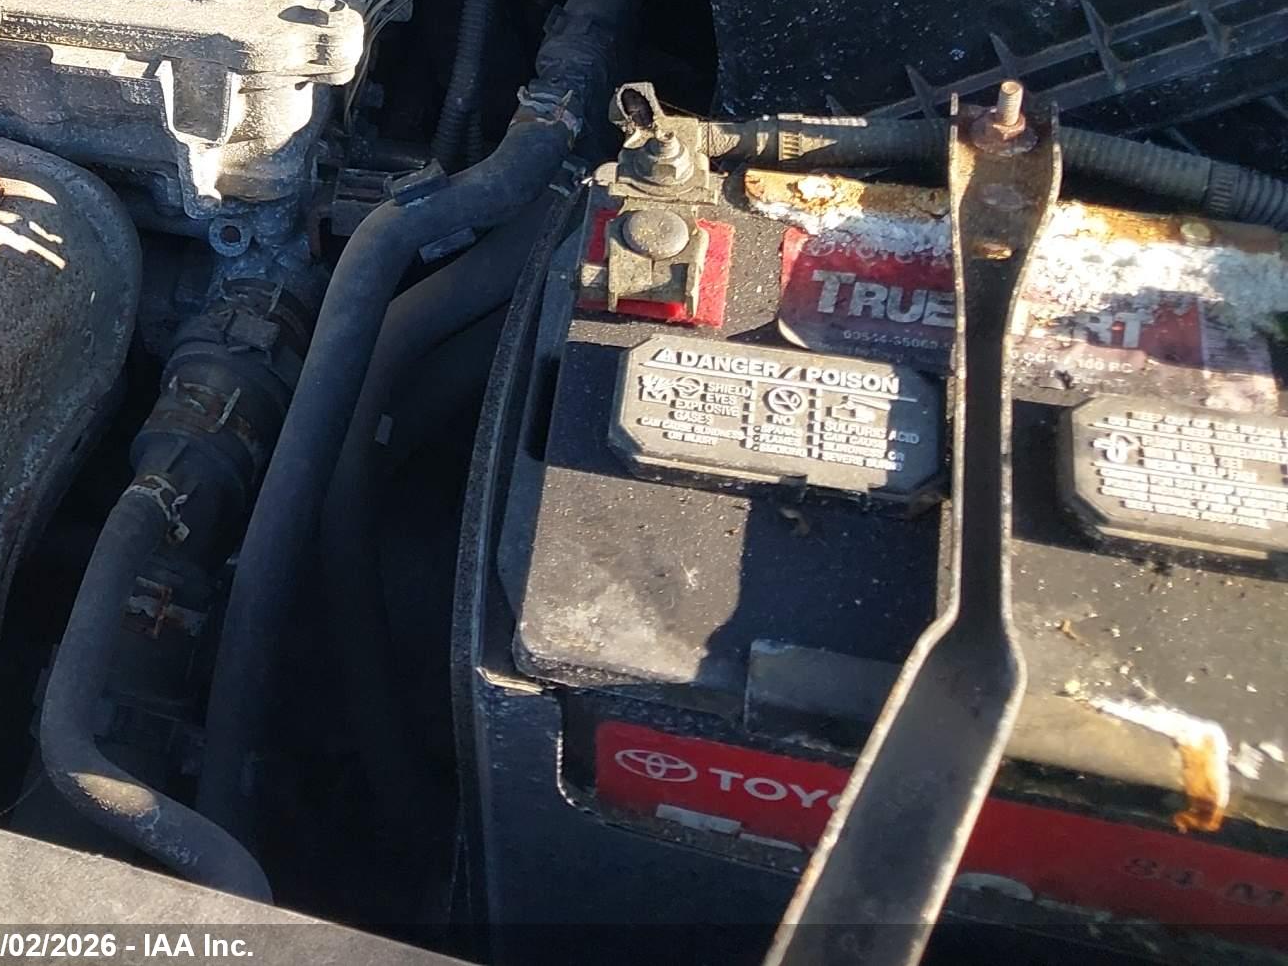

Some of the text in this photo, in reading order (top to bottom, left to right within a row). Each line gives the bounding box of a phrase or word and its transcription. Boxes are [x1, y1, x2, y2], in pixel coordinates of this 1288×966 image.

[679, 351, 782, 378] DANGER
[806, 366, 900, 395] POISON
[675, 399, 741, 418] EXPLOSIVE
[706, 394, 737, 406] EYES
[674, 410, 713, 427] GASES
[773, 415, 794, 426] NO
[888, 430, 919, 444] ACID
[708, 767, 842, 812] TOY
